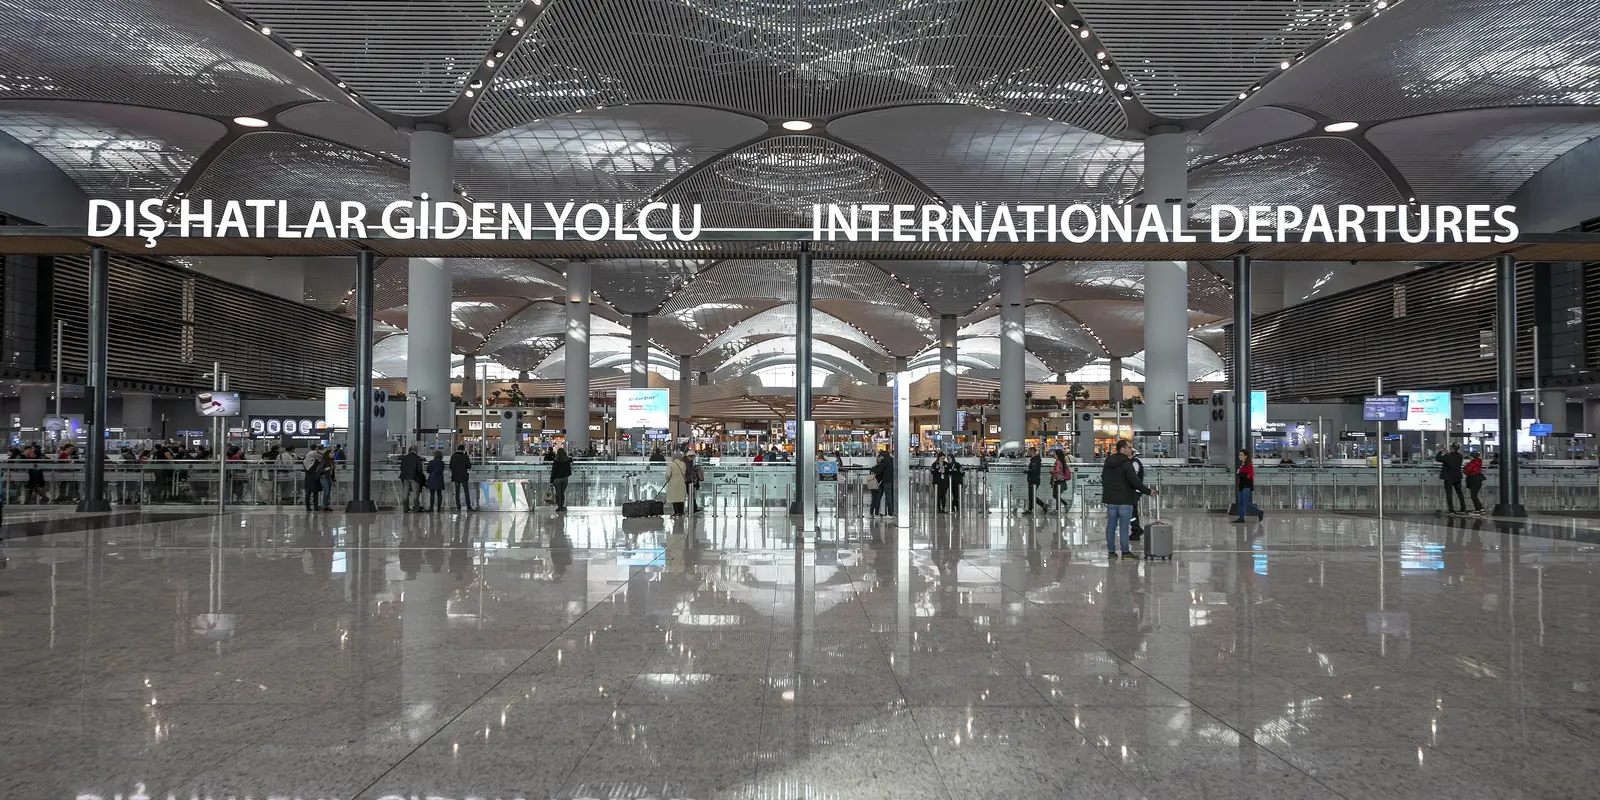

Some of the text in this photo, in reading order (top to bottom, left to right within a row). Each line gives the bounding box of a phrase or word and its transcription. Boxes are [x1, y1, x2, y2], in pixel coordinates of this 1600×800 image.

[87, 192, 702, 248] DIŞ HATLAR GİDEN YOLCU
[811, 203, 1519, 243] INTERNATIONAL DEPARTURES
